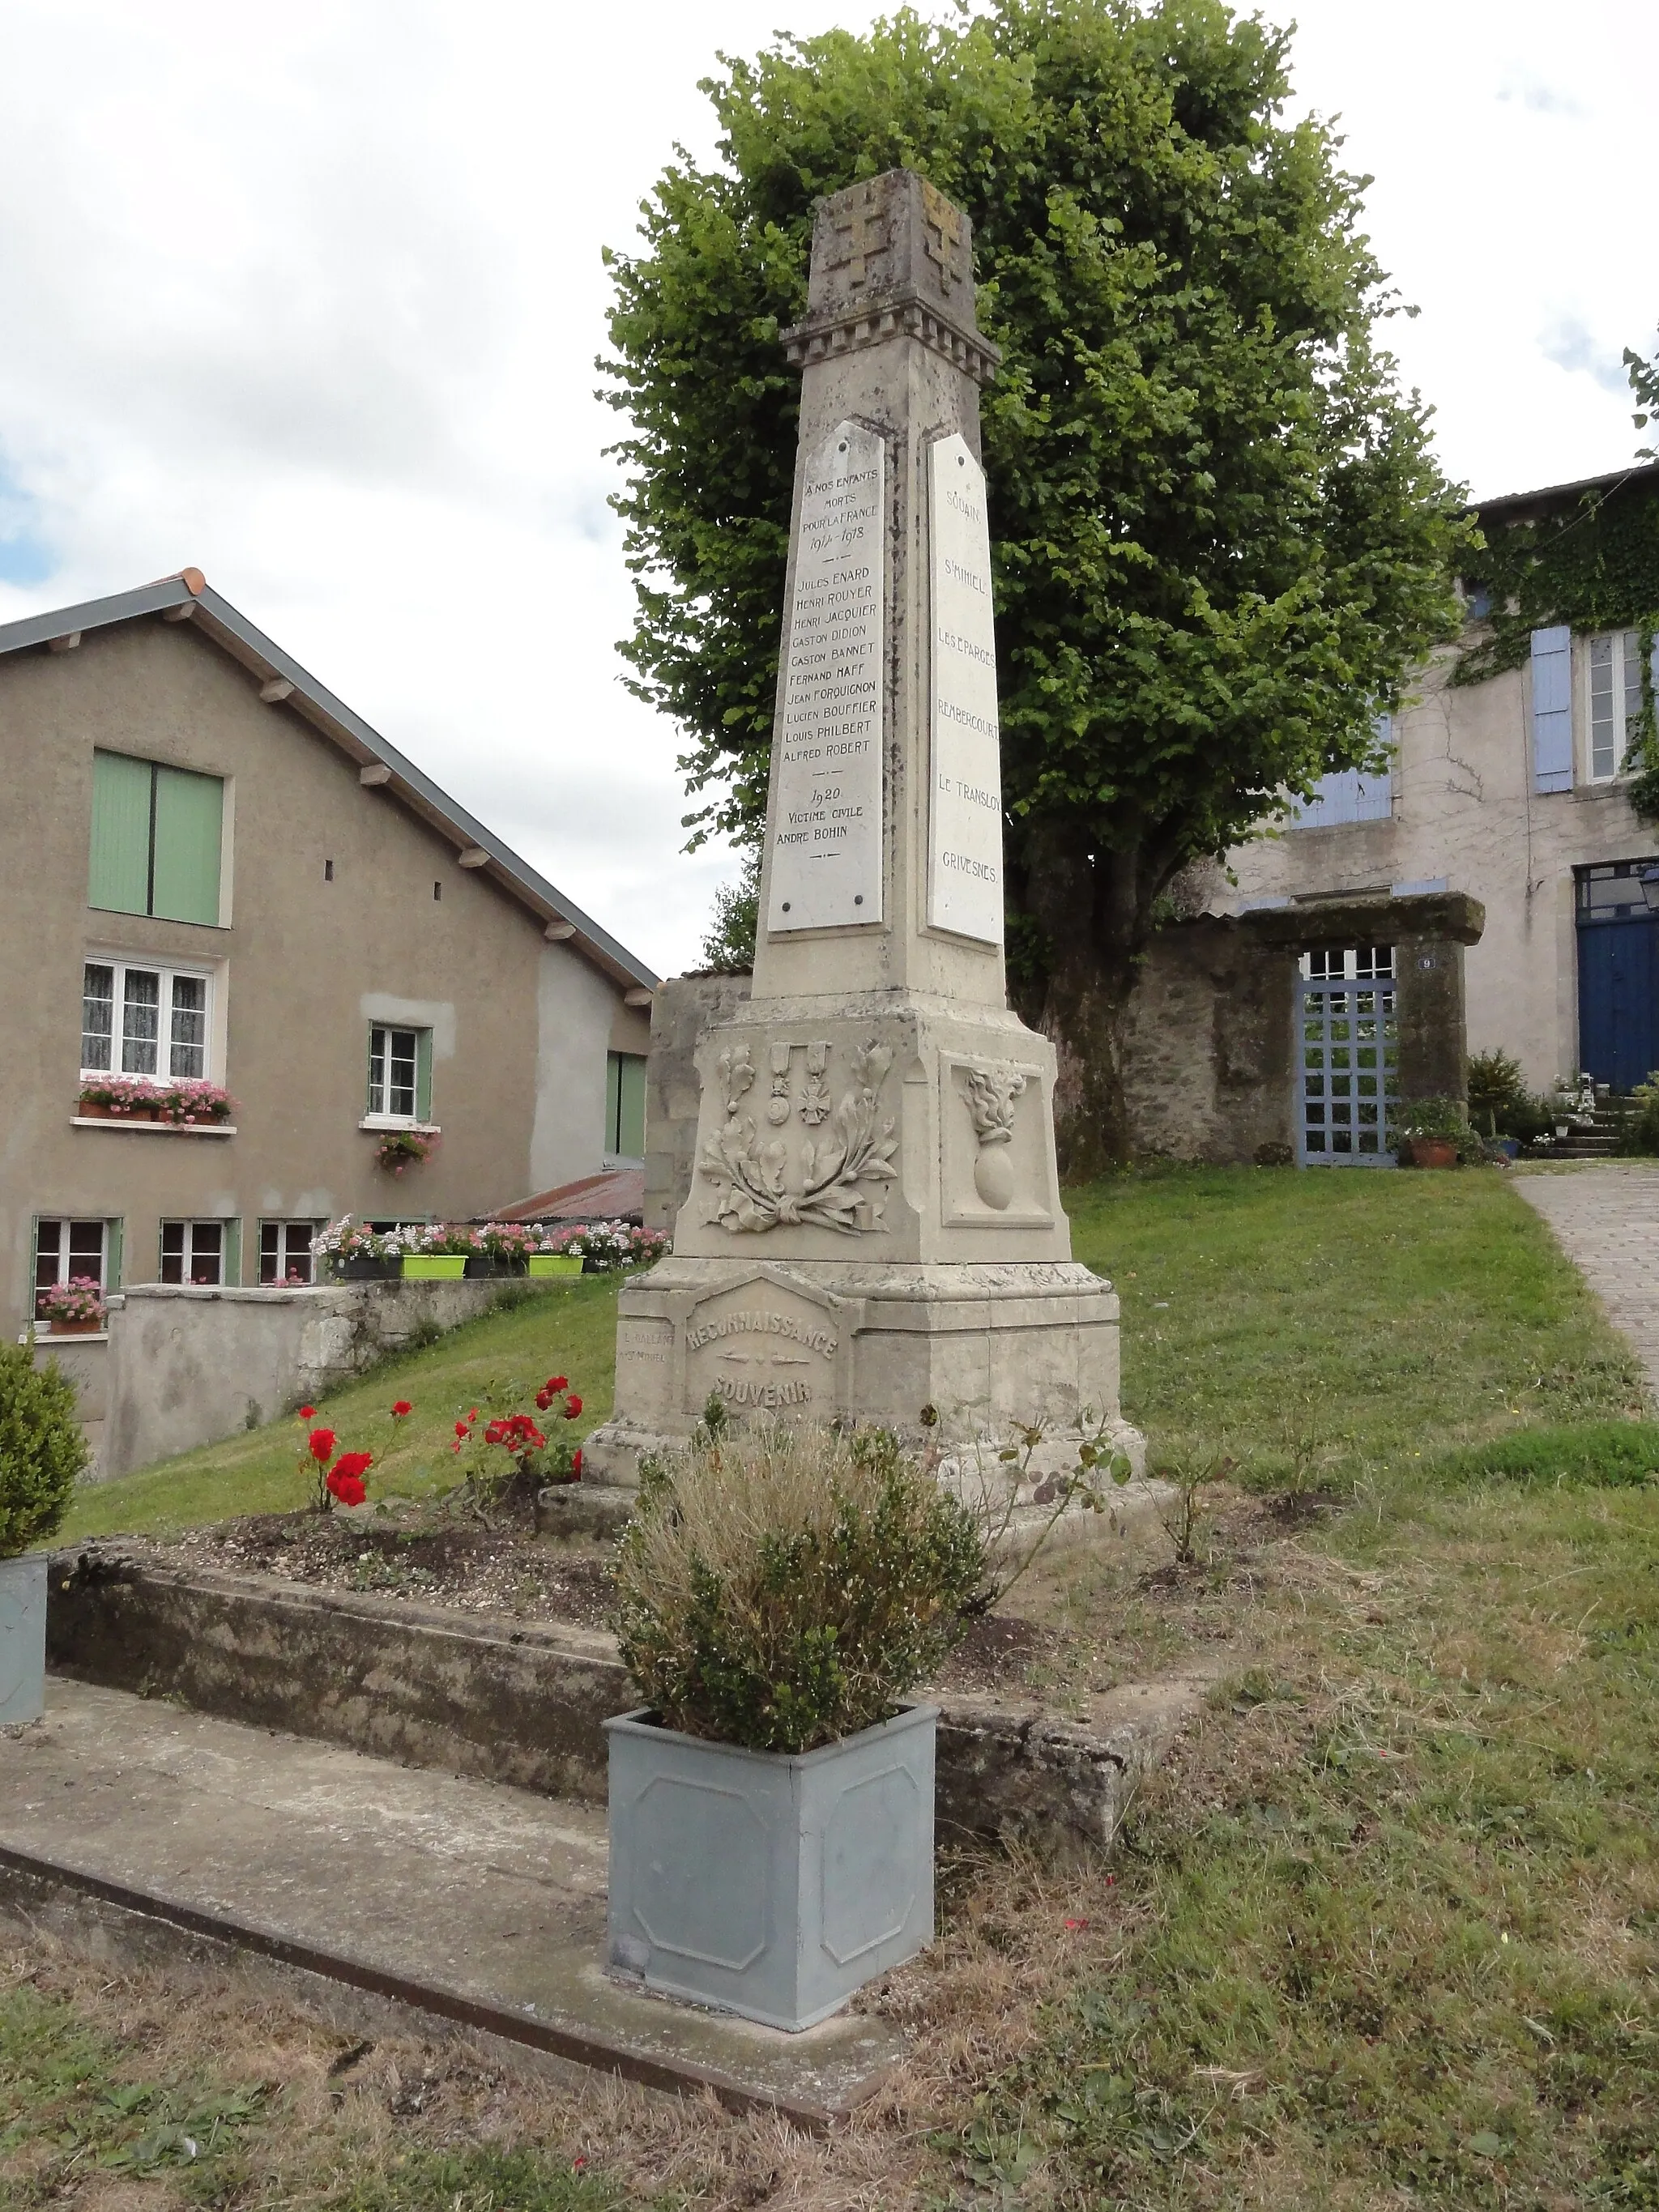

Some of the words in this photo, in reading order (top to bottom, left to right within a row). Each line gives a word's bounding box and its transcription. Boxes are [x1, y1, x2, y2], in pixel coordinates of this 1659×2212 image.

[815, 480, 834, 494] NOS
[836, 469, 878, 488] ENFANTS
[824, 492, 856, 509] MORTS
[803, 520, 825, 533] POUR
[827, 516, 839, 526] LA
[840, 505, 878, 524] FRANCE
[796, 578, 829, 592] JULES
[833, 567, 870, 585] ENARD
[796, 597, 824, 611] HENRI
[828, 585, 872, 606] ROUYER
[794, 616, 821, 630] HENRI
[825, 603, 876, 624] JACQUIER
[792, 633, 828, 648] GASTON
[831, 624, 867, 641] DIDION
[791, 653, 825, 667] GASTON
[831, 641, 875, 660] BANNET
[790, 671, 832, 687] FERNAND
[787, 693, 811, 705] JEAN
[814, 680, 876, 701] FORQUIGNON
[786, 710, 819, 724] LUCIEN
[823, 701, 876, 718] BOUFFIER
[786, 731, 813, 744] LOUIS
[817, 719, 872, 739] PHILBERT
[783, 748, 821, 762] ALFRED
[826, 739, 870, 758] ROBERT
[939, 774, 951, 792] LE
[810, 787, 841, 808] 1920
[788, 810, 826, 825] VICTIME
[832, 806, 864, 819] CIVILE
[776, 831, 809, 845] ANDRE
[814, 825, 848, 841] BOHIN
[1423, 960, 1431, 968] 9
[687, 1311, 839, 1361] RECONNAISSANCE
[712, 1375, 811, 1407] SOUVENIR
